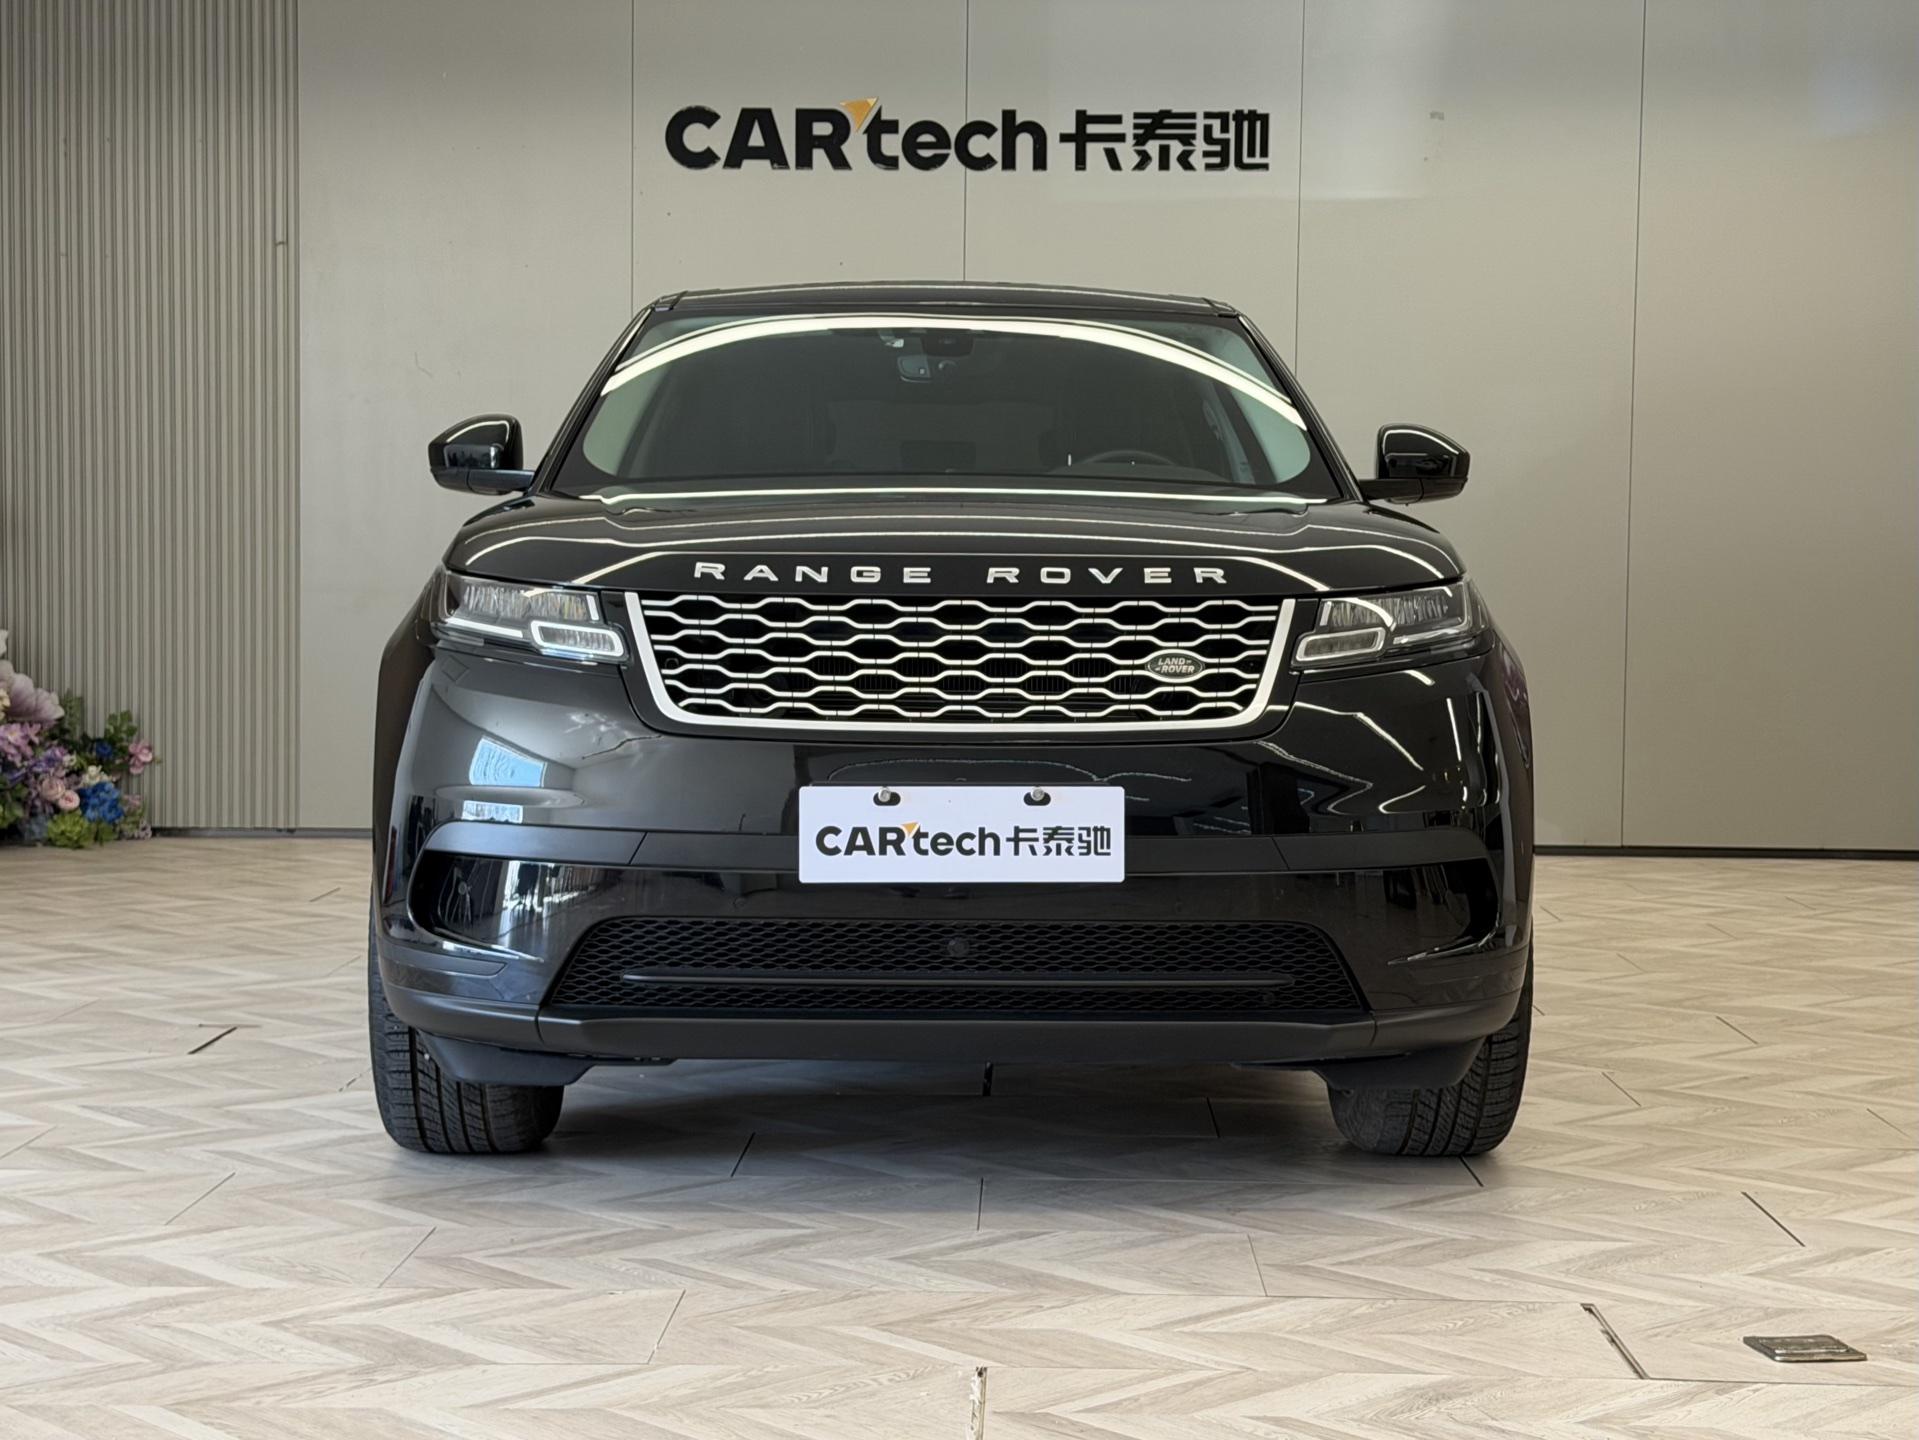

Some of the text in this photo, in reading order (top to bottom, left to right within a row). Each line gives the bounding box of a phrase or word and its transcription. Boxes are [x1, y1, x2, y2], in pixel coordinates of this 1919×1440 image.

[665, 104, 1271, 172] CARtech 卡泰驰
[693, 561, 1228, 585] RANGE ROVER
[815, 825, 1112, 857] CARtech 卡泰驰
